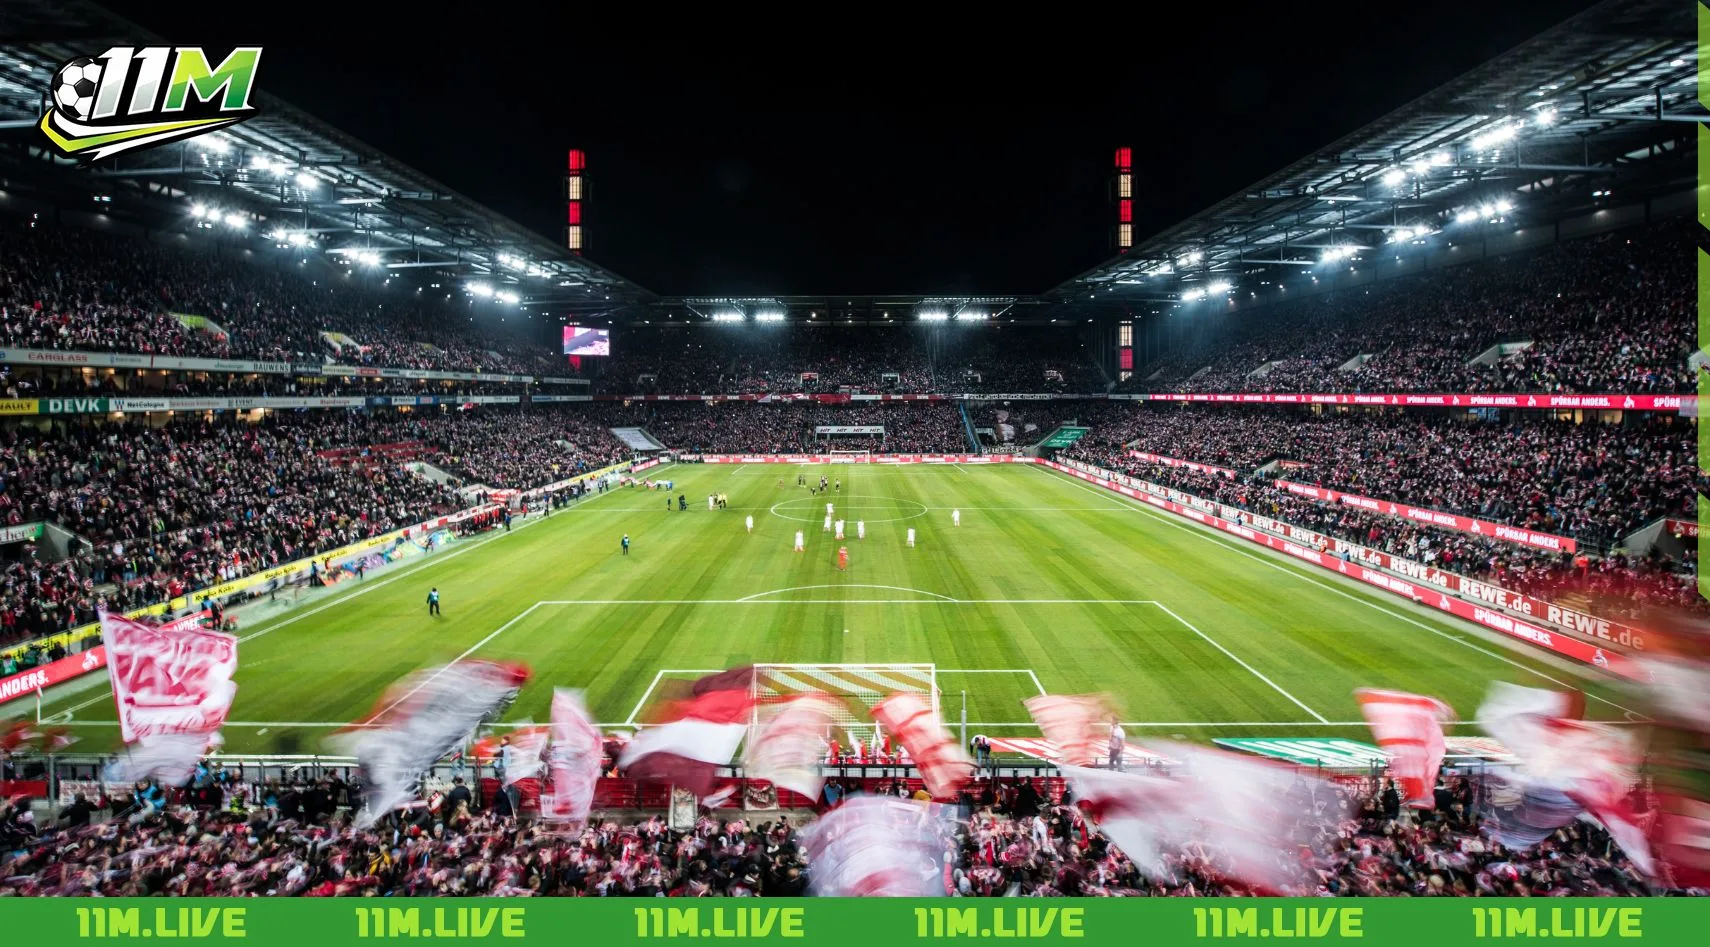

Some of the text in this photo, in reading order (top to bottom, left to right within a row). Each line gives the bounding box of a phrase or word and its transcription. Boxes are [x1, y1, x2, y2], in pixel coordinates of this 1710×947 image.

[28, 352, 88, 362] CARGLASS
[253, 362, 289, 372] BAUWENS
[50, 399, 100, 413] DEVK
[127, 401, 165, 409] NetCologne
[1550, 395, 1611, 407] SPÜRBAR ANDERS.
[1253, 515, 1285, 534] REWE.de
[1290, 523, 1328, 546] REWE.de
[1495, 526, 1528, 543] SPÜRBAR
[1335, 539, 1381, 565] REWE.de
[1390, 556, 1448, 587] REWE.de
[1459, 578, 1532, 615] REWE.de
[1474, 607, 1555, 648] SPÜRBAR ANDERS.
[1547, 605, 1644, 649] REWE.de
[0, 670, 49, 698] NDERS.
